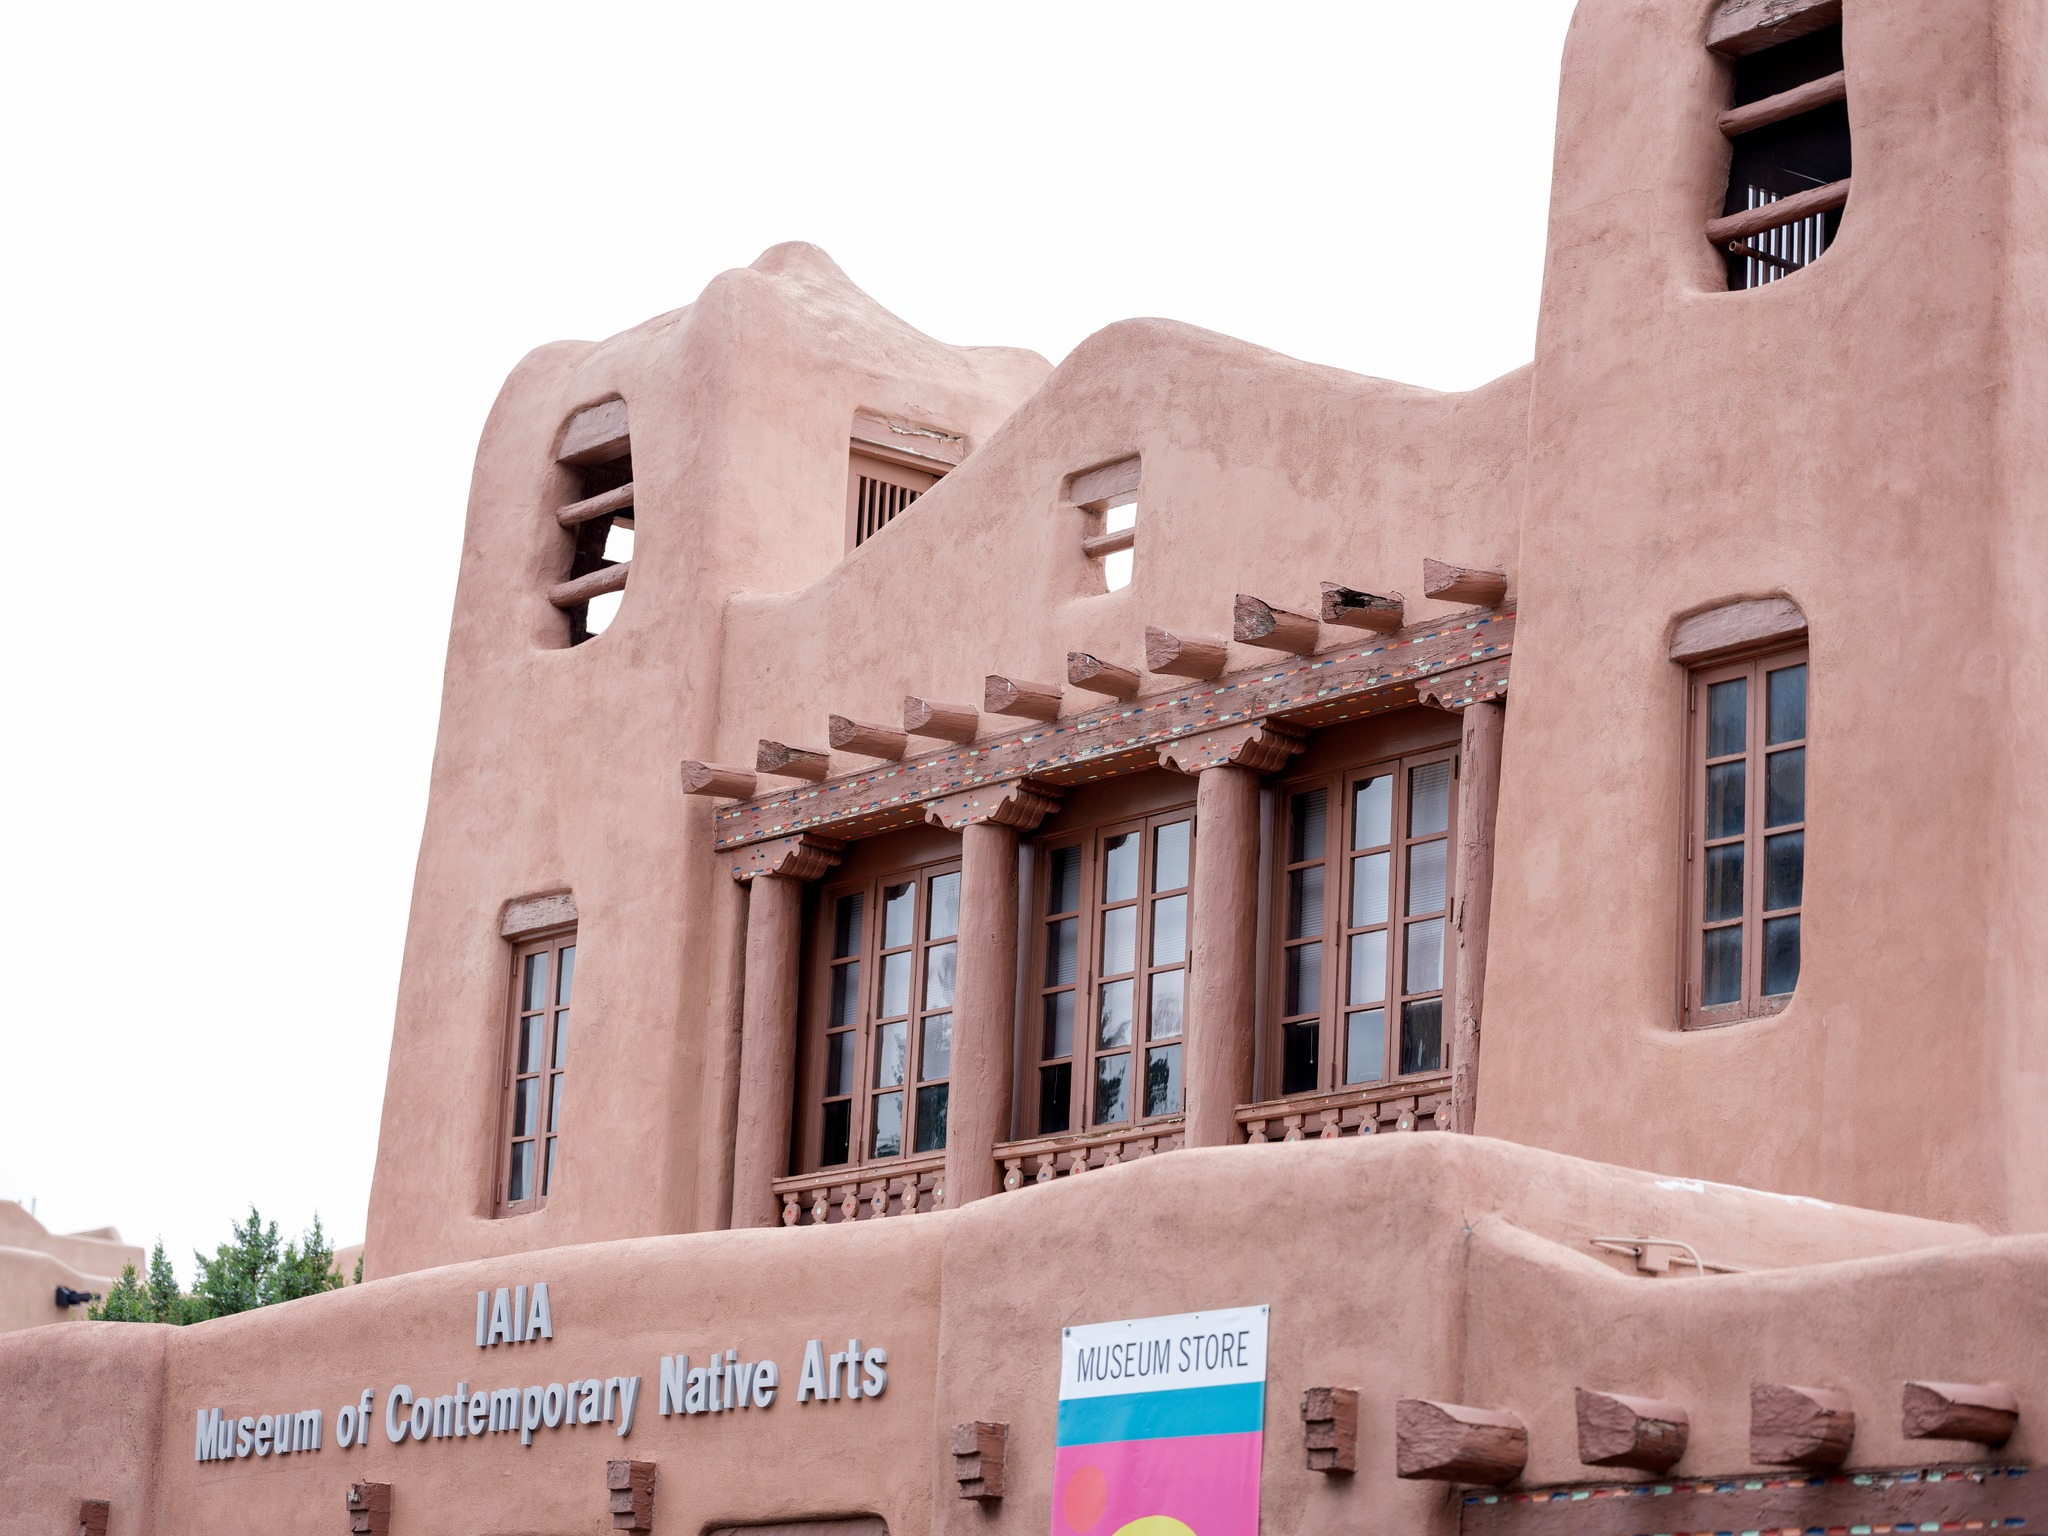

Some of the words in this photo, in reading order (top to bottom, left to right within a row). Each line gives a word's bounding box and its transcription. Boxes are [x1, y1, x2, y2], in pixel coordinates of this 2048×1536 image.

[477, 1282, 553, 1347] IAIA
[1077, 1339, 1171, 1382] MUSEUM
[1178, 1330, 1250, 1373] STORE
[195, 1407, 322, 1461] Museum
[335, 1388, 375, 1448] of
[385, 1375, 642, 1445] Contemporary
[659, 1349, 780, 1416] Native
[797, 1339, 888, 1402] Arts
